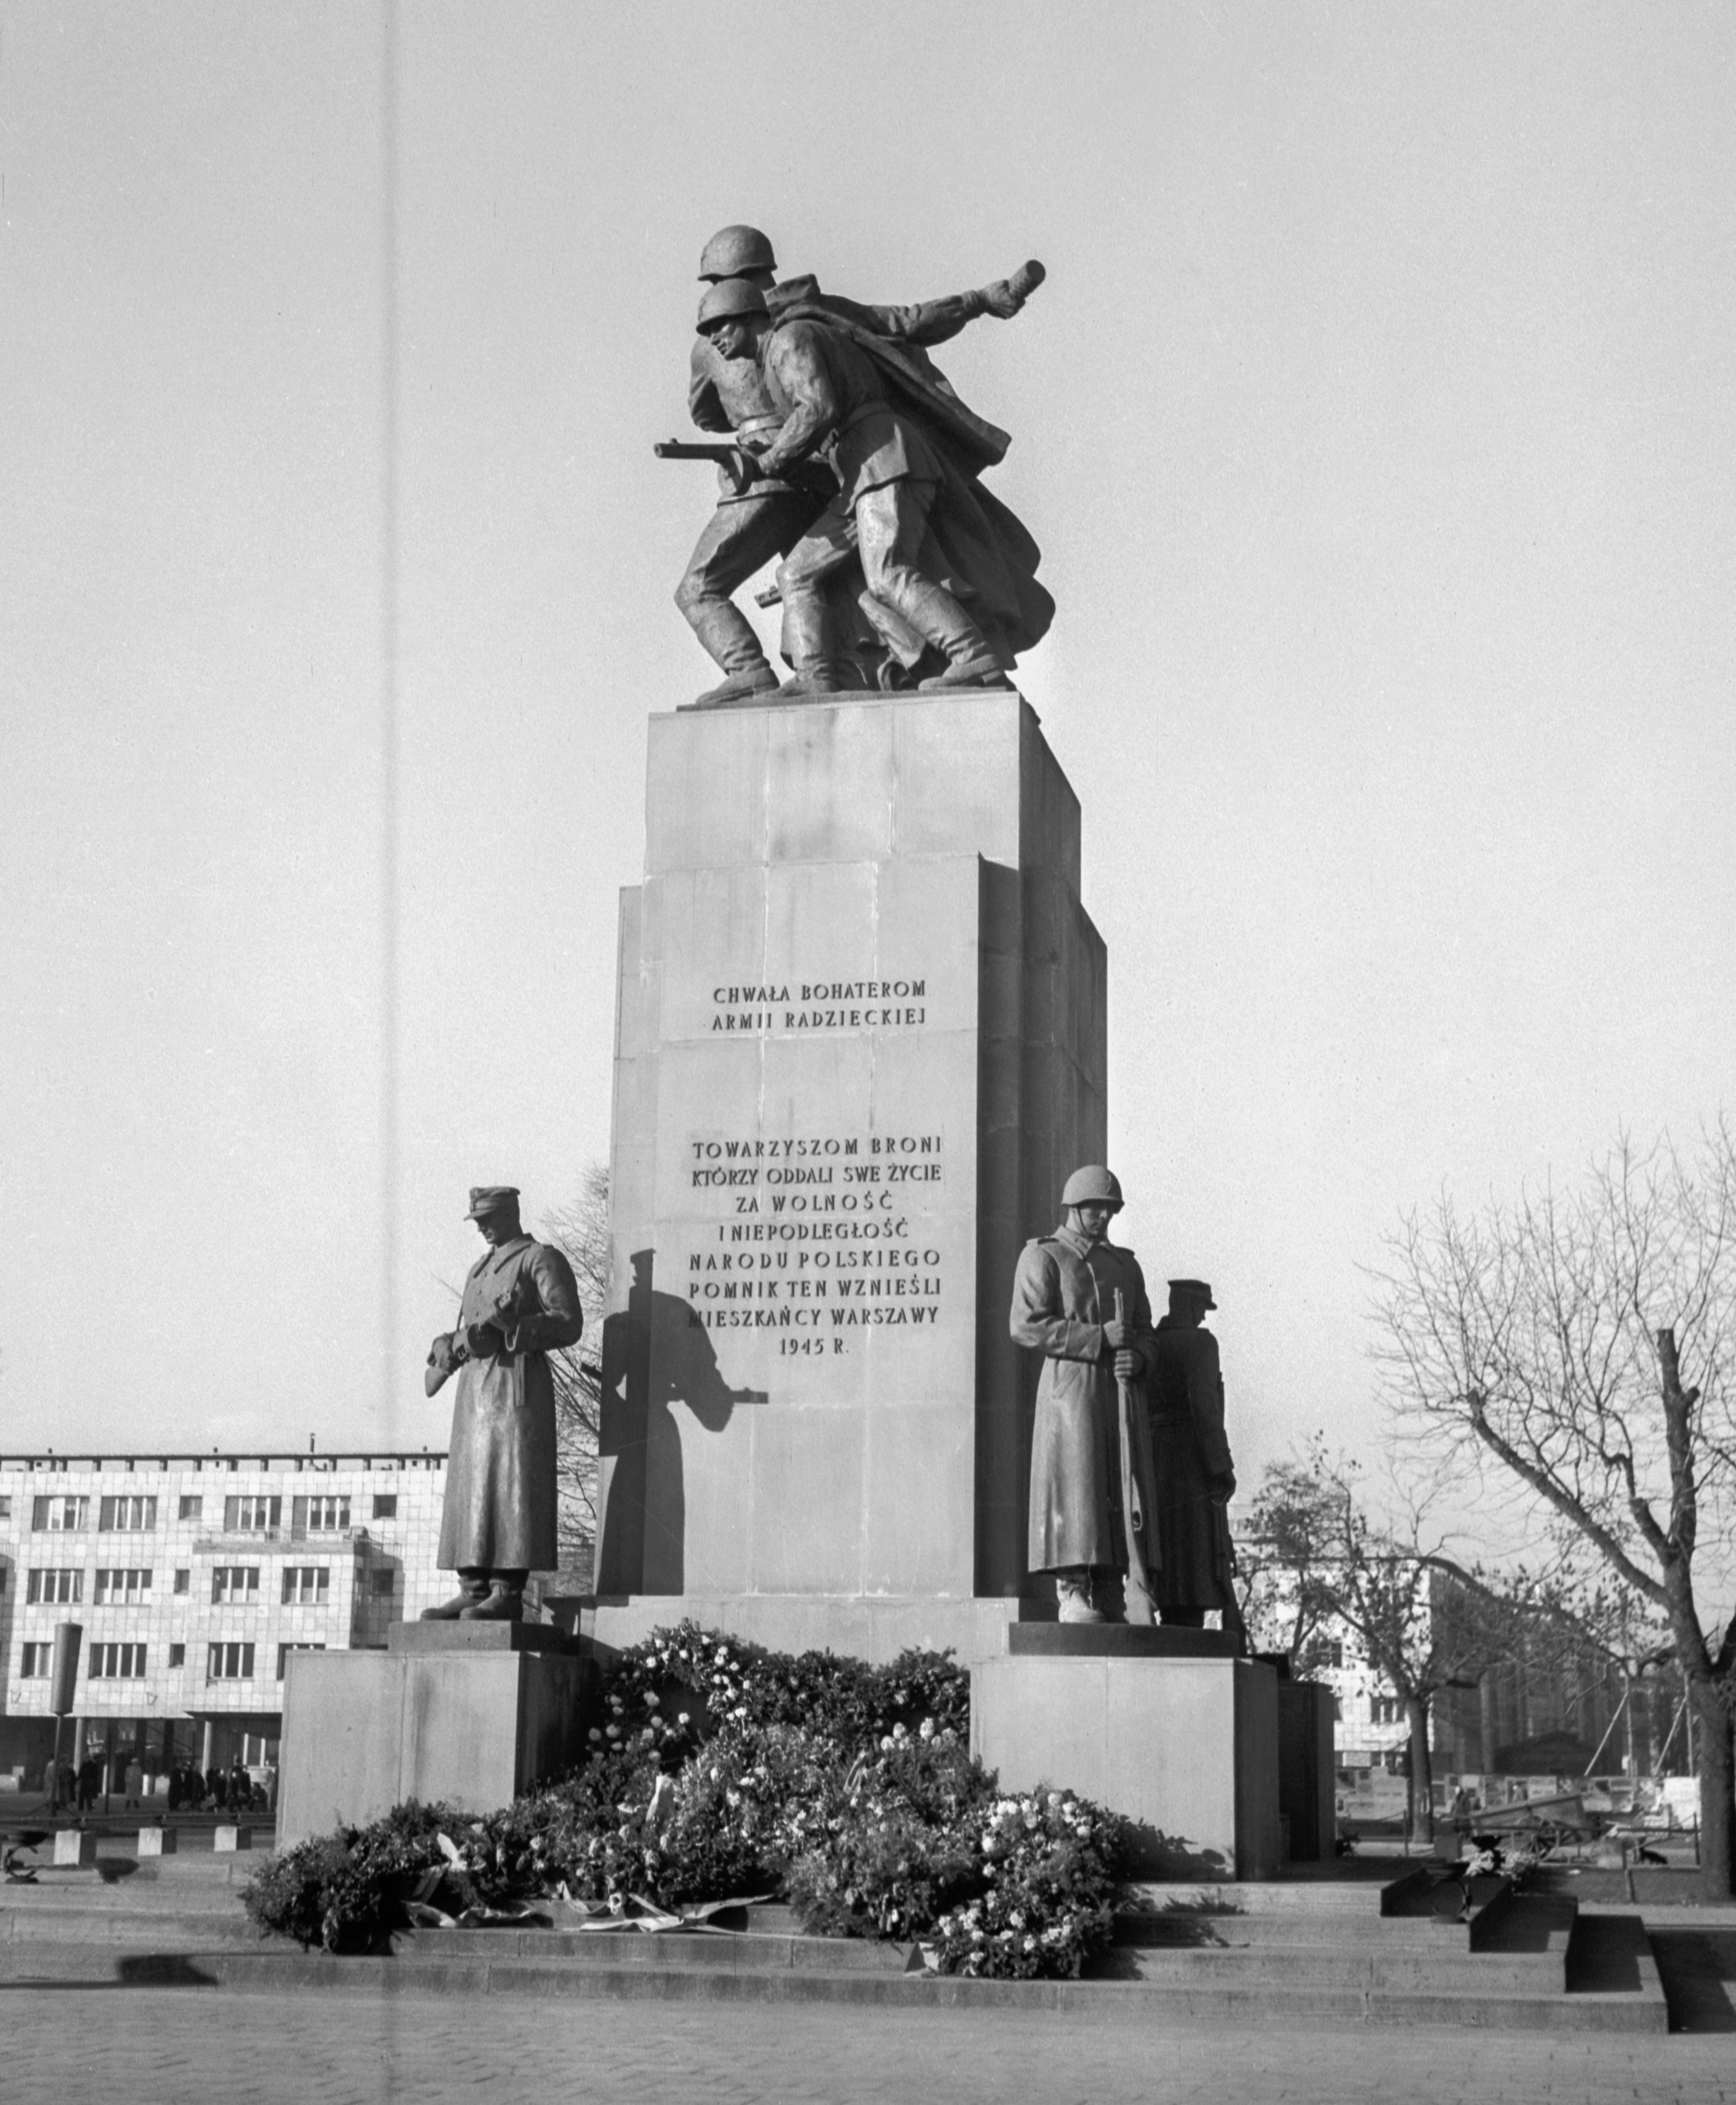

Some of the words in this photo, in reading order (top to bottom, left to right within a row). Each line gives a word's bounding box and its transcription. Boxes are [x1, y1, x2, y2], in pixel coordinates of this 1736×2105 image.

[713, 986, 790, 1004] CHWAŁA
[801, 980, 925, 1001] BOHATEROM
[712, 1013, 772, 1031] ARMII
[785, 1008, 925, 1028] RADZIECKIEJ
[692, 1138, 858, 1159] TOWARZYSZOM
[871, 1136, 941, 1154] BRONI
[692, 1167, 759, 1187] KTÓRZY
[766, 1167, 833, 1184] ODDALI
[844, 1165, 880, 1183] SWE
[888, 1163, 941, 1182] ŻYCIE
[736, 1197, 759, 1213] ZA
[772, 1190, 892, 1212] WOLNOŚĆ
[720, 1226, 724, 1242] I
[731, 1217, 908, 1242] NIEPODLEGŁOŚĆ
[690, 1252, 787, 1271] NARODU
[798, 1250, 940, 1268] POLSKIEGO
[690, 1281, 778, 1299] POMNIK
[787, 1280, 827, 1298] TEN
[837, 1274, 940, 1297] WZNIEŚLI
[688, 1305, 821, 1327] MIESZKAŃCY
[830, 1306, 938, 1326] WARSZAWY
[781, 1338, 824, 1355] 1945
